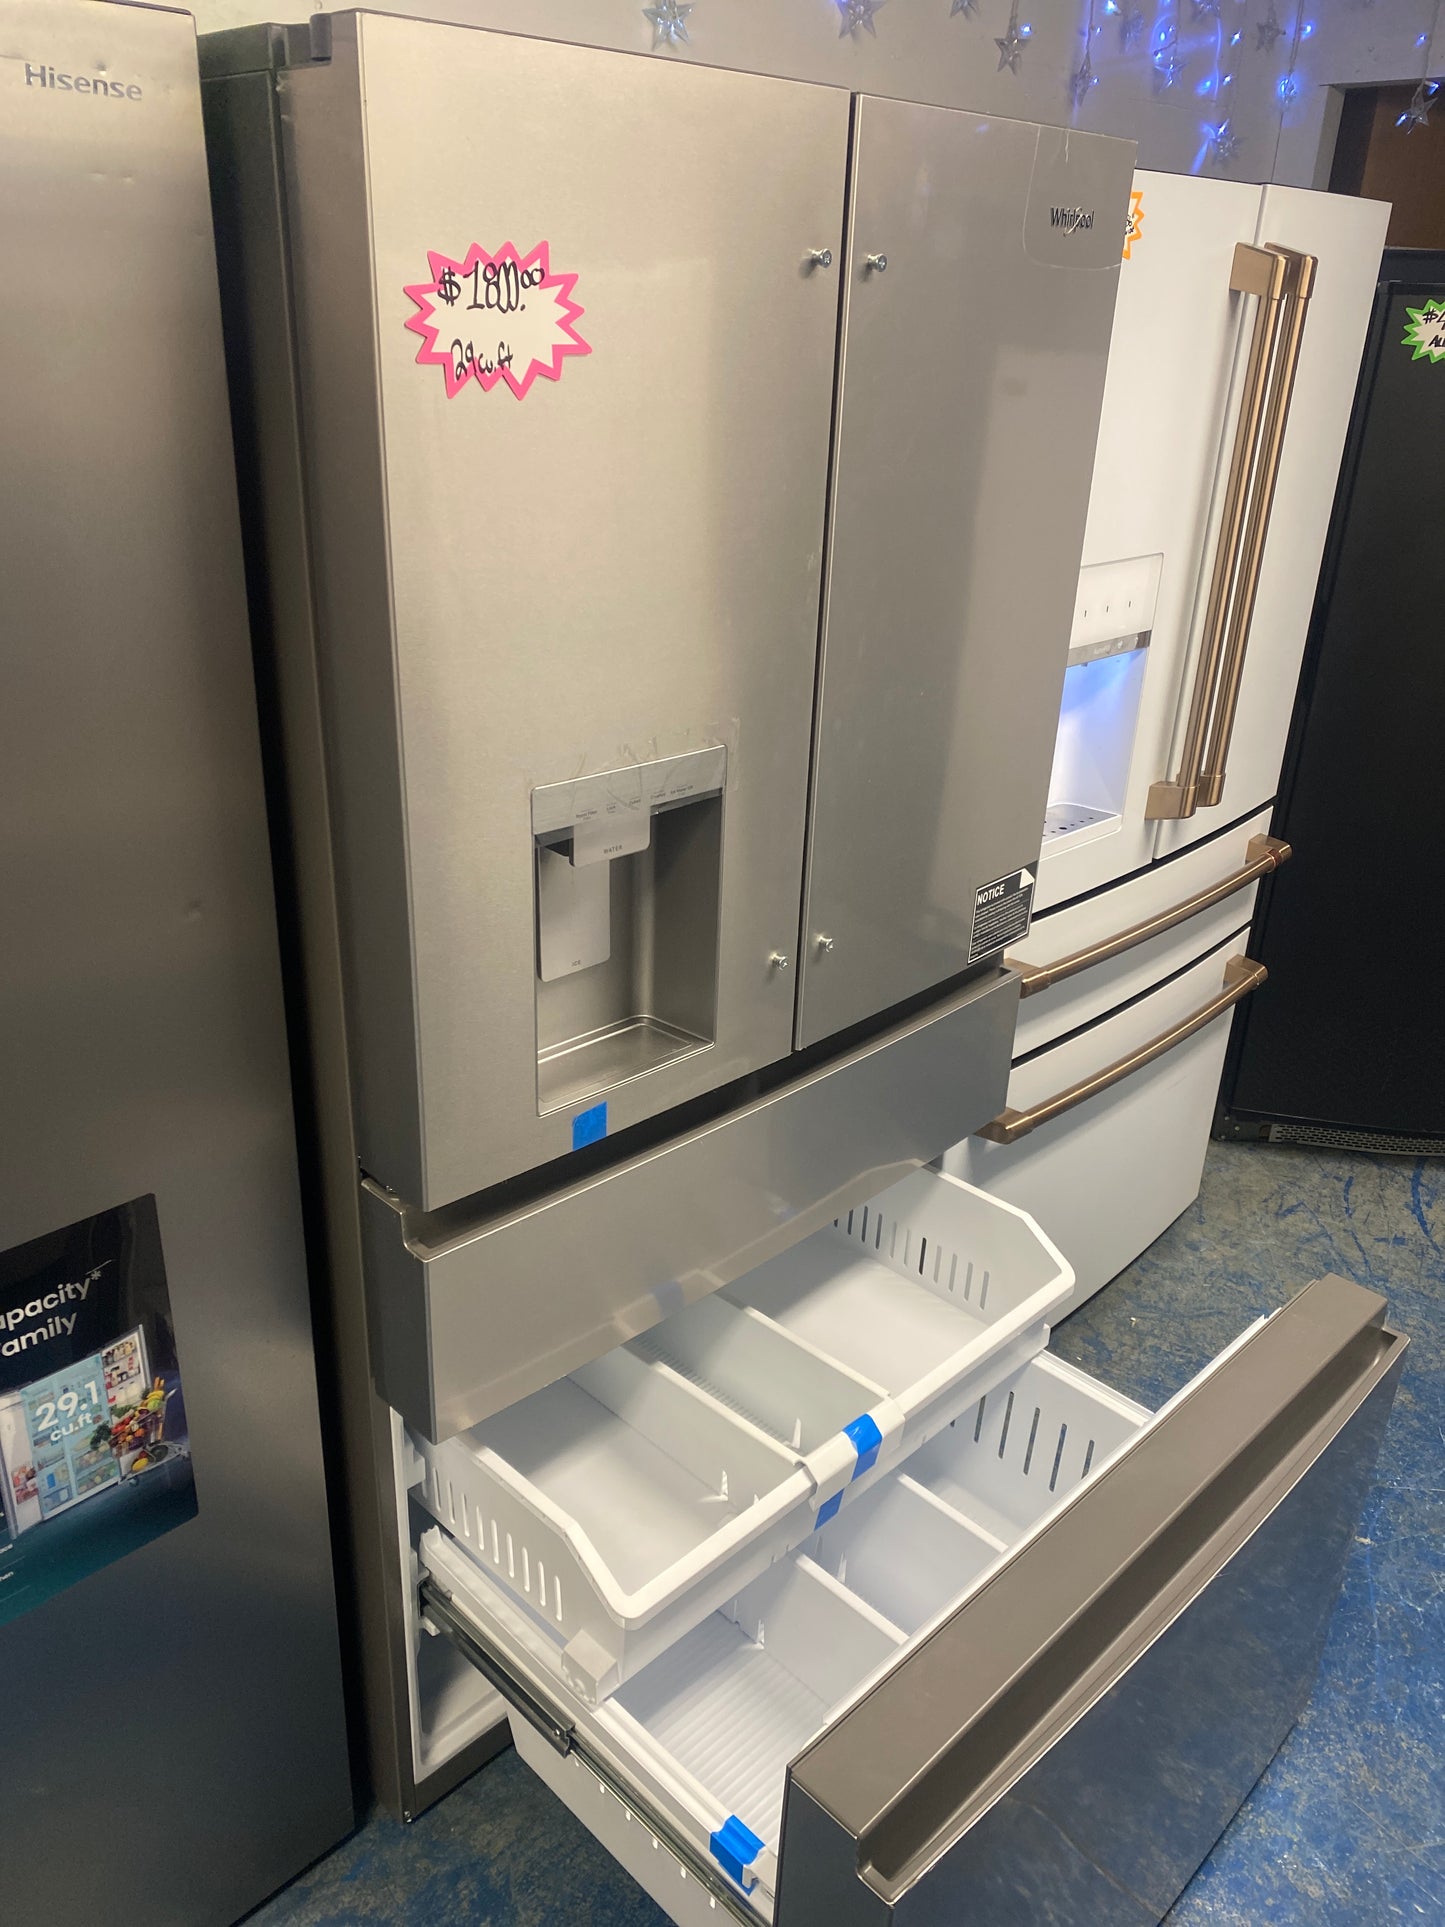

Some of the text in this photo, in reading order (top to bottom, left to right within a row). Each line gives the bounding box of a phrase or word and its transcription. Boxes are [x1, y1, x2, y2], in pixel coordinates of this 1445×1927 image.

[25, 63, 142, 101] Hisense
[1050, 206, 1095, 233] Whirlpool
[977, 884, 1006, 906] NOTICE
[0, 1312, 77, 1357] amily
[36, 1380, 98, 1432] 29.1
[50, 1412, 92, 1442] cu.ft
